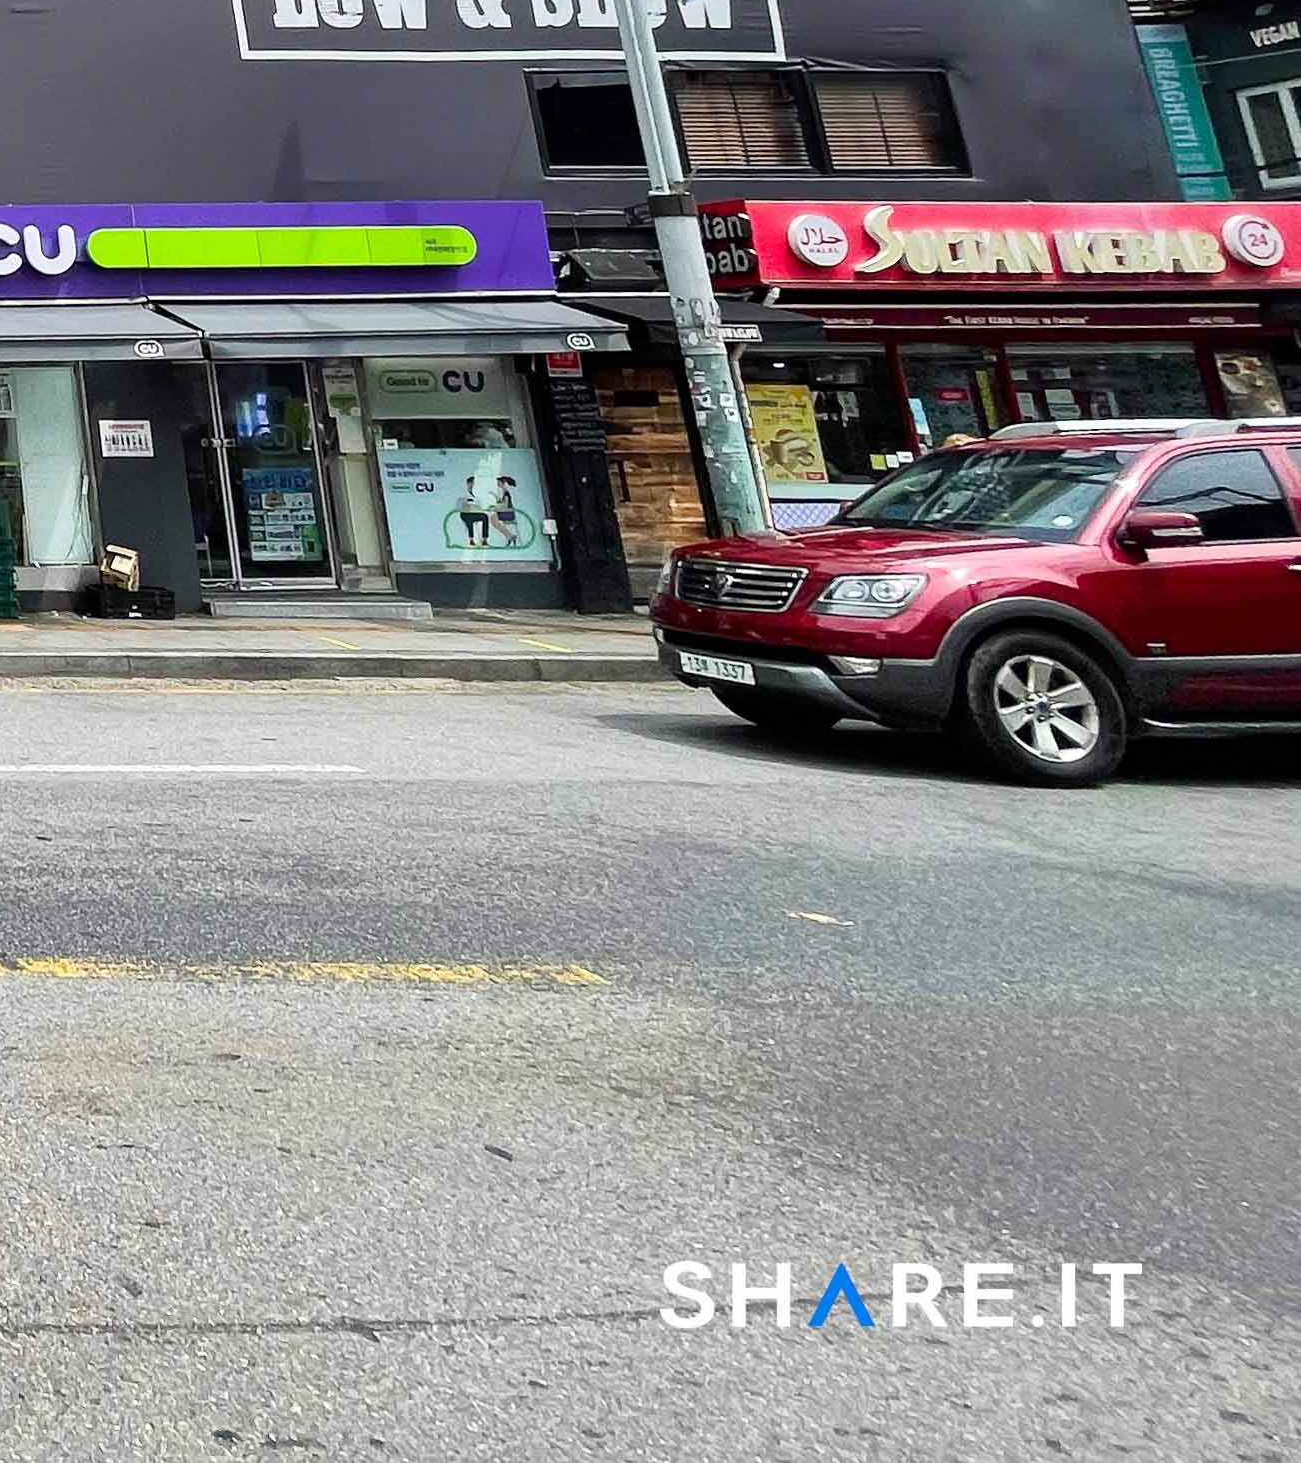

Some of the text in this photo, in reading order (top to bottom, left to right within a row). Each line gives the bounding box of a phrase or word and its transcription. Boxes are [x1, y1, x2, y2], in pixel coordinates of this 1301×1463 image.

[801, 227, 843, 246] حلال
[1249, 232, 1268, 248] 24
[442, 370, 485, 393] CU
[415, 482, 435, 493] CU
